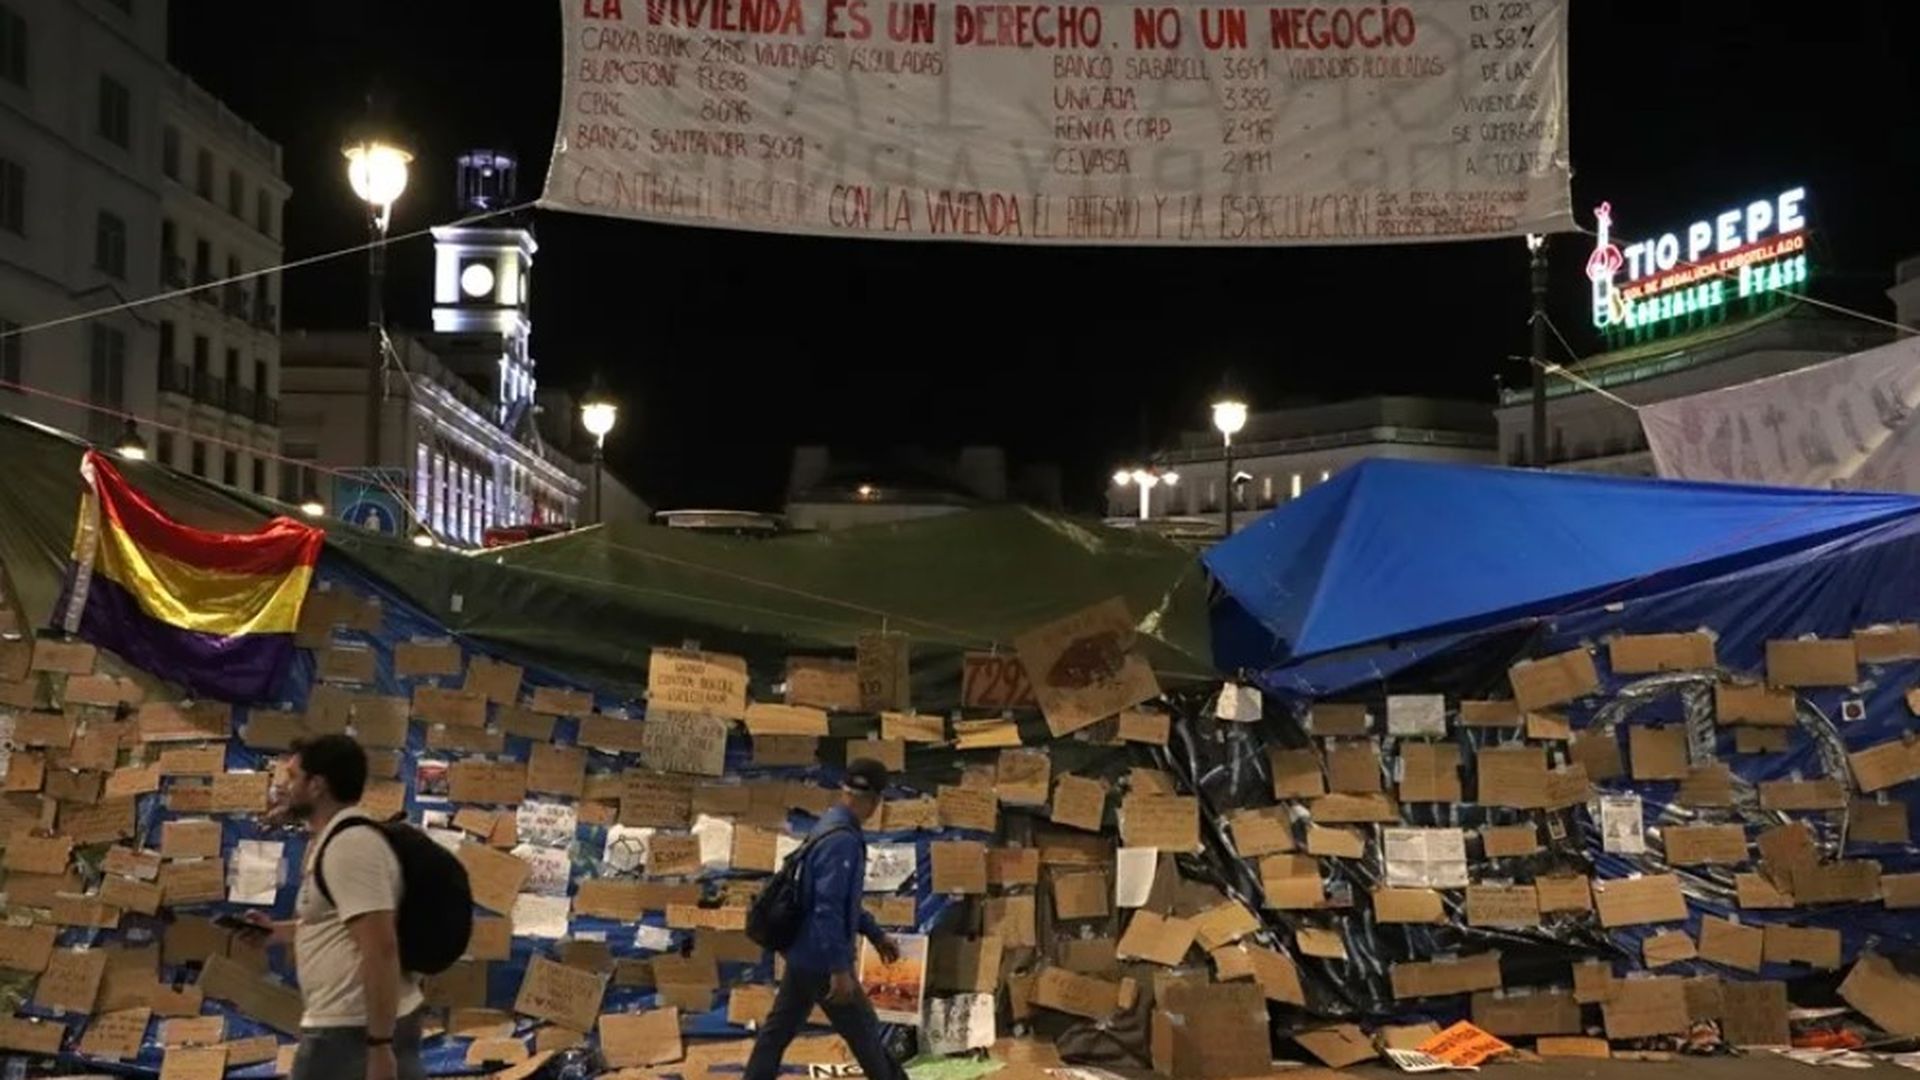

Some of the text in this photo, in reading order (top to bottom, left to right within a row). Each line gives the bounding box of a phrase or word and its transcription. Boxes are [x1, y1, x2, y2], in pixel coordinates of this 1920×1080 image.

[649, 0, 804, 35] VIVIENDA
[825, 2, 872, 40] ES
[888, 2, 936, 44] UN
[1134, 7, 1181, 50] NO
[1201, 8, 1247, 50] UN
[1270, 4, 1416, 50] NEGOCIO
[1470, 33, 1489, 49] EL
[1053, 55, 1115, 80] BANCO
[1125, 56, 1211, 82] SABADELL
[1481, 63, 1501, 82] DE
[1053, 86, 1137, 111] UNICAJA
[1123, 118, 1173, 142] CORP
[1452, 126, 1470, 143] SE
[1053, 148, 1132, 174] CEVASA
[828, 184, 872, 230] CON
[883, 187, 912, 232] LA
[924, 188, 1023, 238] VIVIENDA
[1154, 194, 1169, 239] Y
[1624, 187, 1806, 281] TIO PEPE
